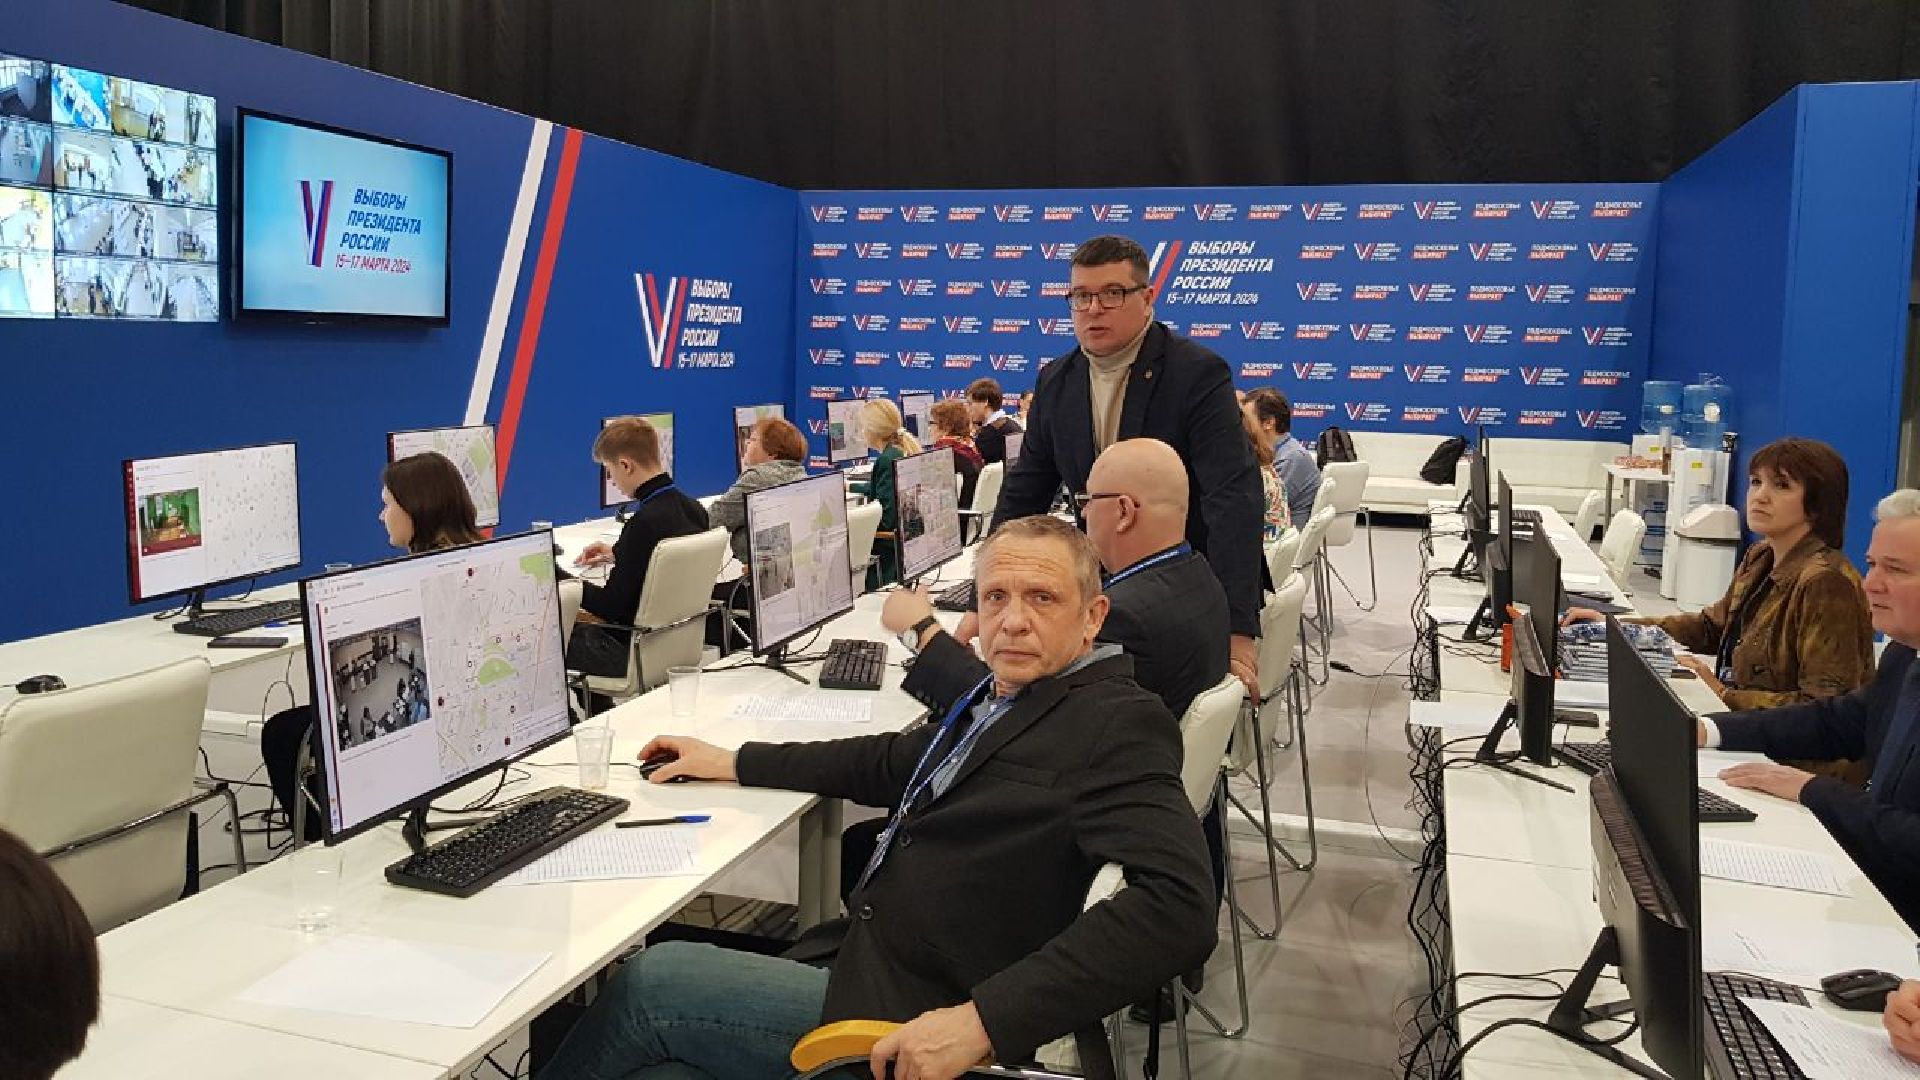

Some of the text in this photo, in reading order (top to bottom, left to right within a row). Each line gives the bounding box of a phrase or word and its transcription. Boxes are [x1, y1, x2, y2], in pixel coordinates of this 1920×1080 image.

[353, 188, 408, 211] ВЫБОРЫ
[347, 210, 421, 235] ПРЕЗИДЕНТА
[340, 232, 390, 252] РОССИИ
[1188, 241, 1256, 255] ВЫБОРЫ
[361, 255, 391, 271] МАРТА
[391, 258, 411, 273] 2024
[1180, 258, 1274, 274] ПРЕЗИДЕНТА
[691, 279, 732, 299] ВЫБОРЫ
[1172, 276, 1233, 289] РОССИИ
[1195, 293, 1231, 304] МАРТА
[1232, 293, 1259, 304] 2024
[686, 303, 742, 325] ПРЕЗИДЕНТА
[681, 328, 720, 346] РОССИИ
